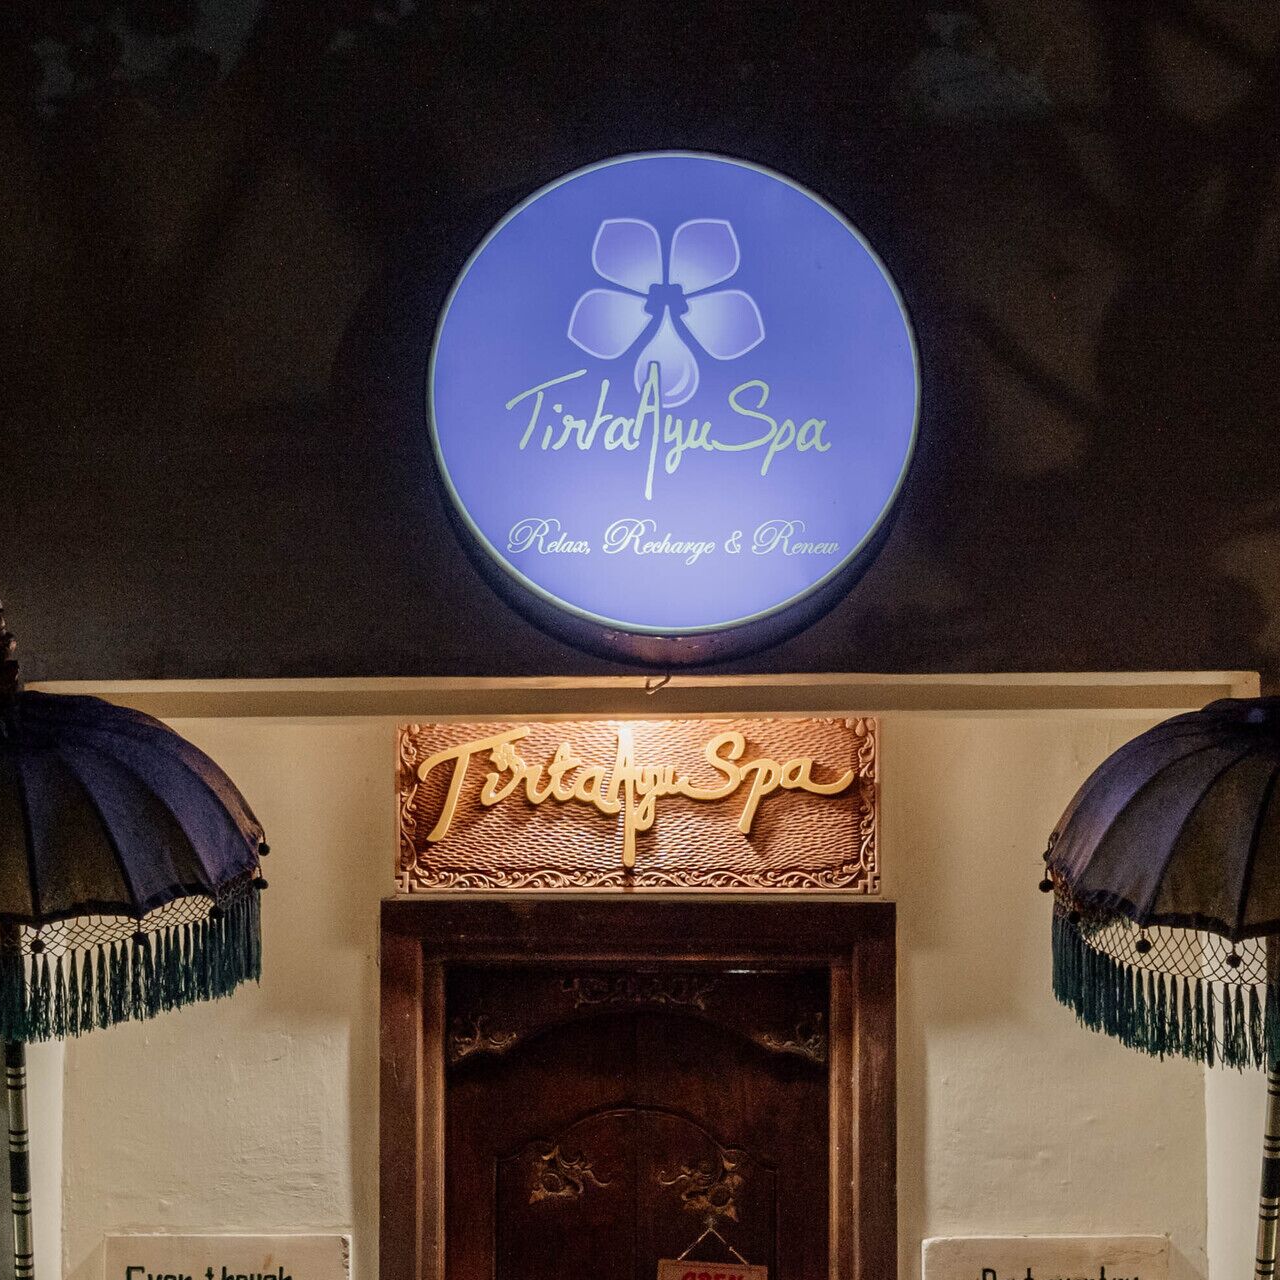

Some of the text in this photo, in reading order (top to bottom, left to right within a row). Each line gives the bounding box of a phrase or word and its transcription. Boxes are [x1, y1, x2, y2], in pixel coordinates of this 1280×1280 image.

[713, 379, 832, 476] Spa
[507, 518, 840, 565] Relax, Recharge & Renew
[687, 731, 854, 835] Spa
